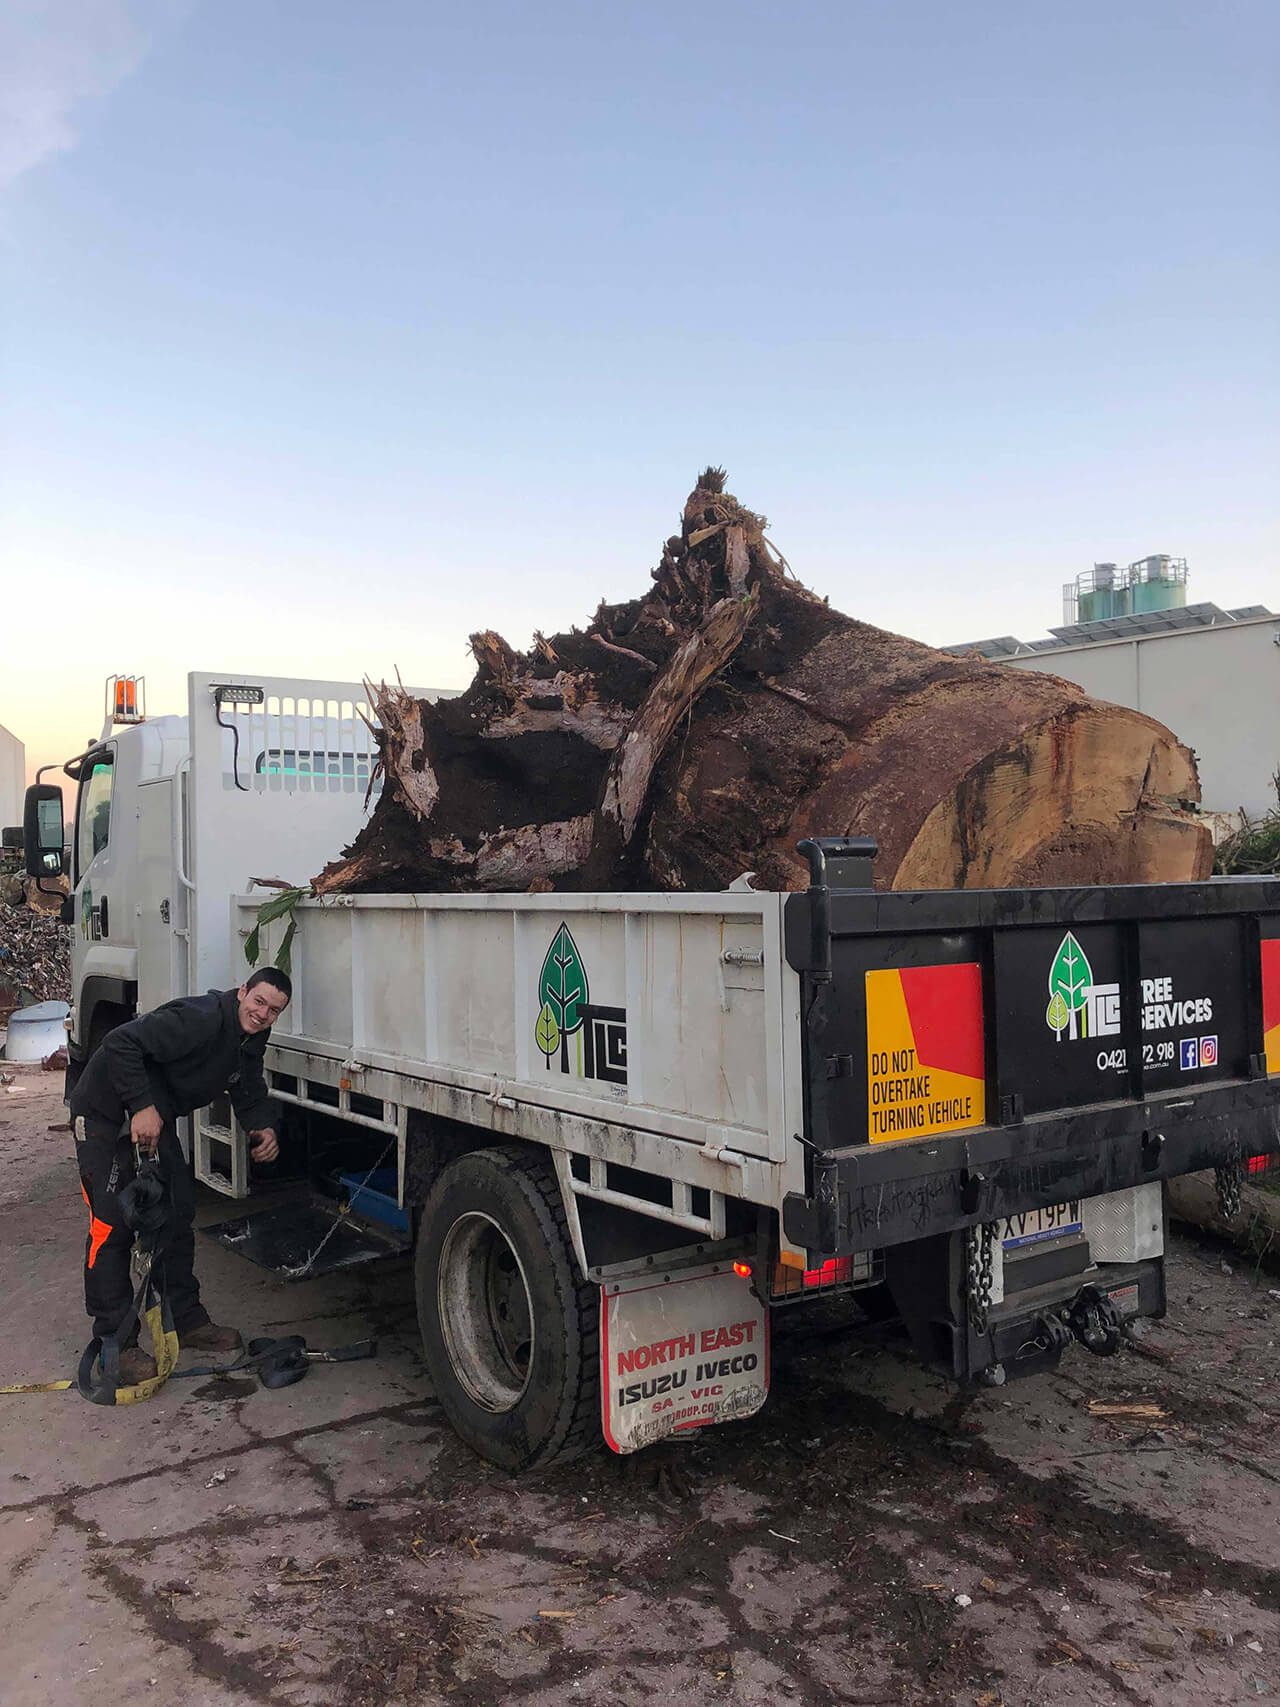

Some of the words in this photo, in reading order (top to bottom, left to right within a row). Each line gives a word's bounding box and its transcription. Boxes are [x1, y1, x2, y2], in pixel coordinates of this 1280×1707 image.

[1140, 976, 1173, 1004] REE
[872, 1052, 888, 1076] DO
[892, 1049, 915, 1073] NOT
[1096, 1049, 1126, 1070] 0421
[1157, 1041, 1175, 1061] 918
[872, 1075, 931, 1105] OVERTAKE
[872, 1104, 925, 1134] TURNING
[928, 1097, 972, 1125] VEHICLE
[617, 1333, 695, 1376] NORTH
[700, 1320, 758, 1353] EAST
[619, 1369, 688, 1407] ISUZU
[695, 1353, 758, 1382] IVECO
[652, 1401, 674, 1414] SA
[690, 1384, 724, 1400] VIC
